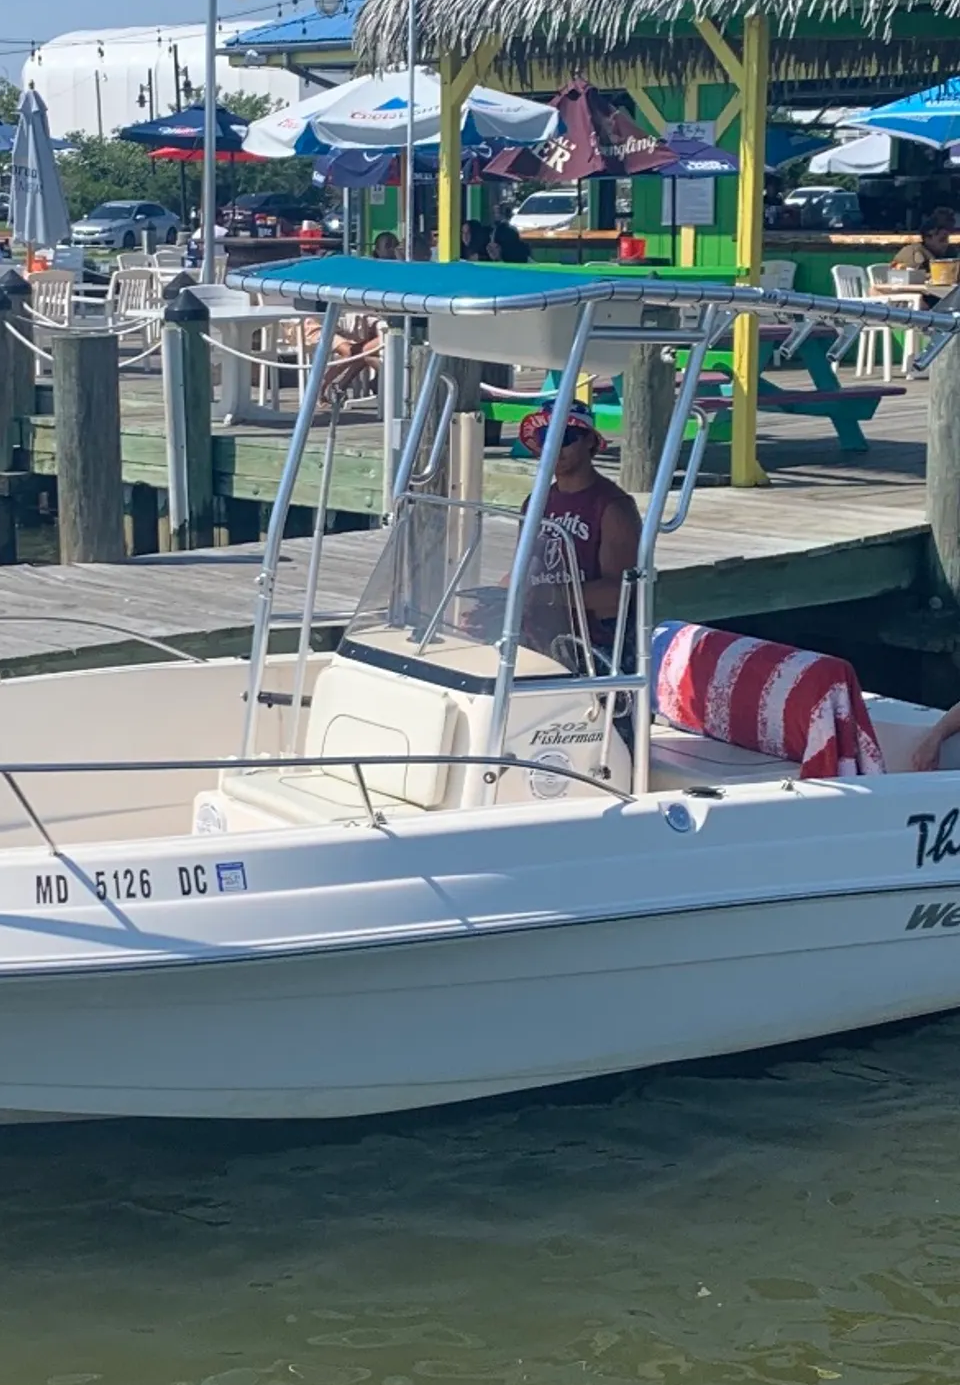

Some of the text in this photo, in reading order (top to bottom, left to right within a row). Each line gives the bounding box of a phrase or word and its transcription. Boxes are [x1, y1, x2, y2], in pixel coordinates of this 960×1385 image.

[549, 722, 589, 732] 202
[529, 730, 604, 746] Fisherman
[36, 875, 69, 904] MD
[94, 869, 152, 901] 5126
[178, 865, 208, 896] DC
